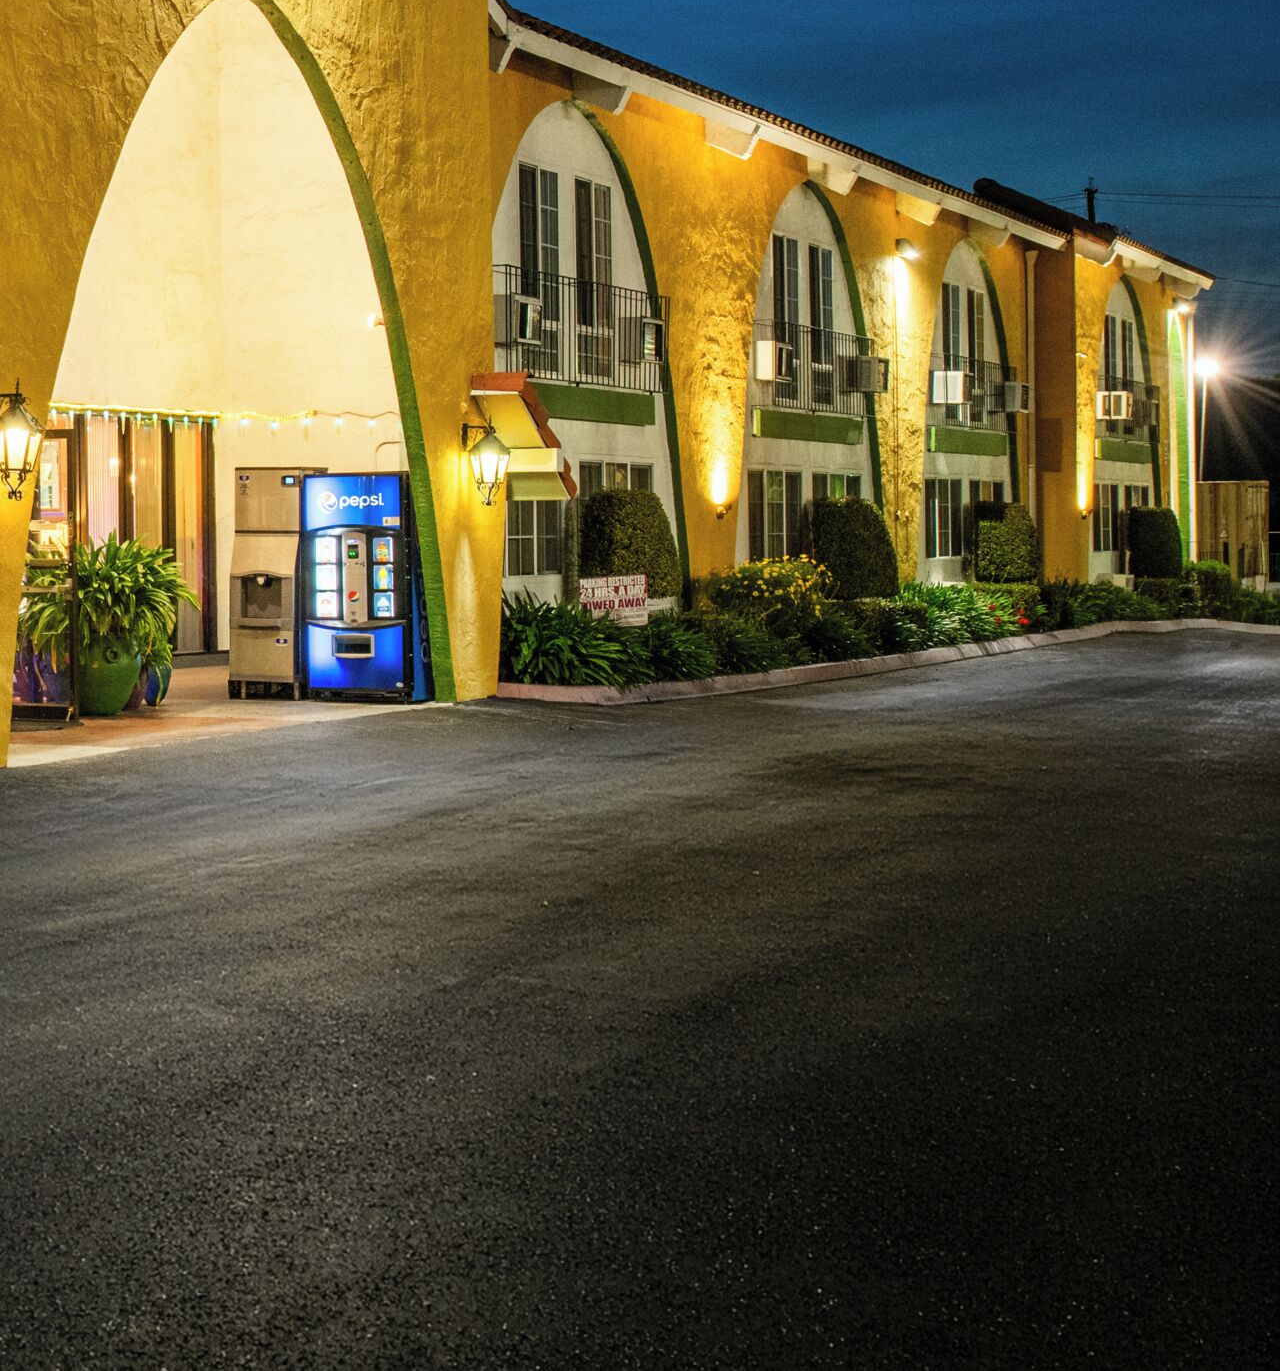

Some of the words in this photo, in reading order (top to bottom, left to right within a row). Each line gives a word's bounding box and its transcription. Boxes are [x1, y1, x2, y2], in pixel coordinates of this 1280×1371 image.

[580, 578, 607, 589] PARKING
[608, 575, 645, 586] RESTRICTED
[580, 588, 593, 598] 24
[618, 586, 626, 596] A
[618, 597, 646, 608] AWAY
